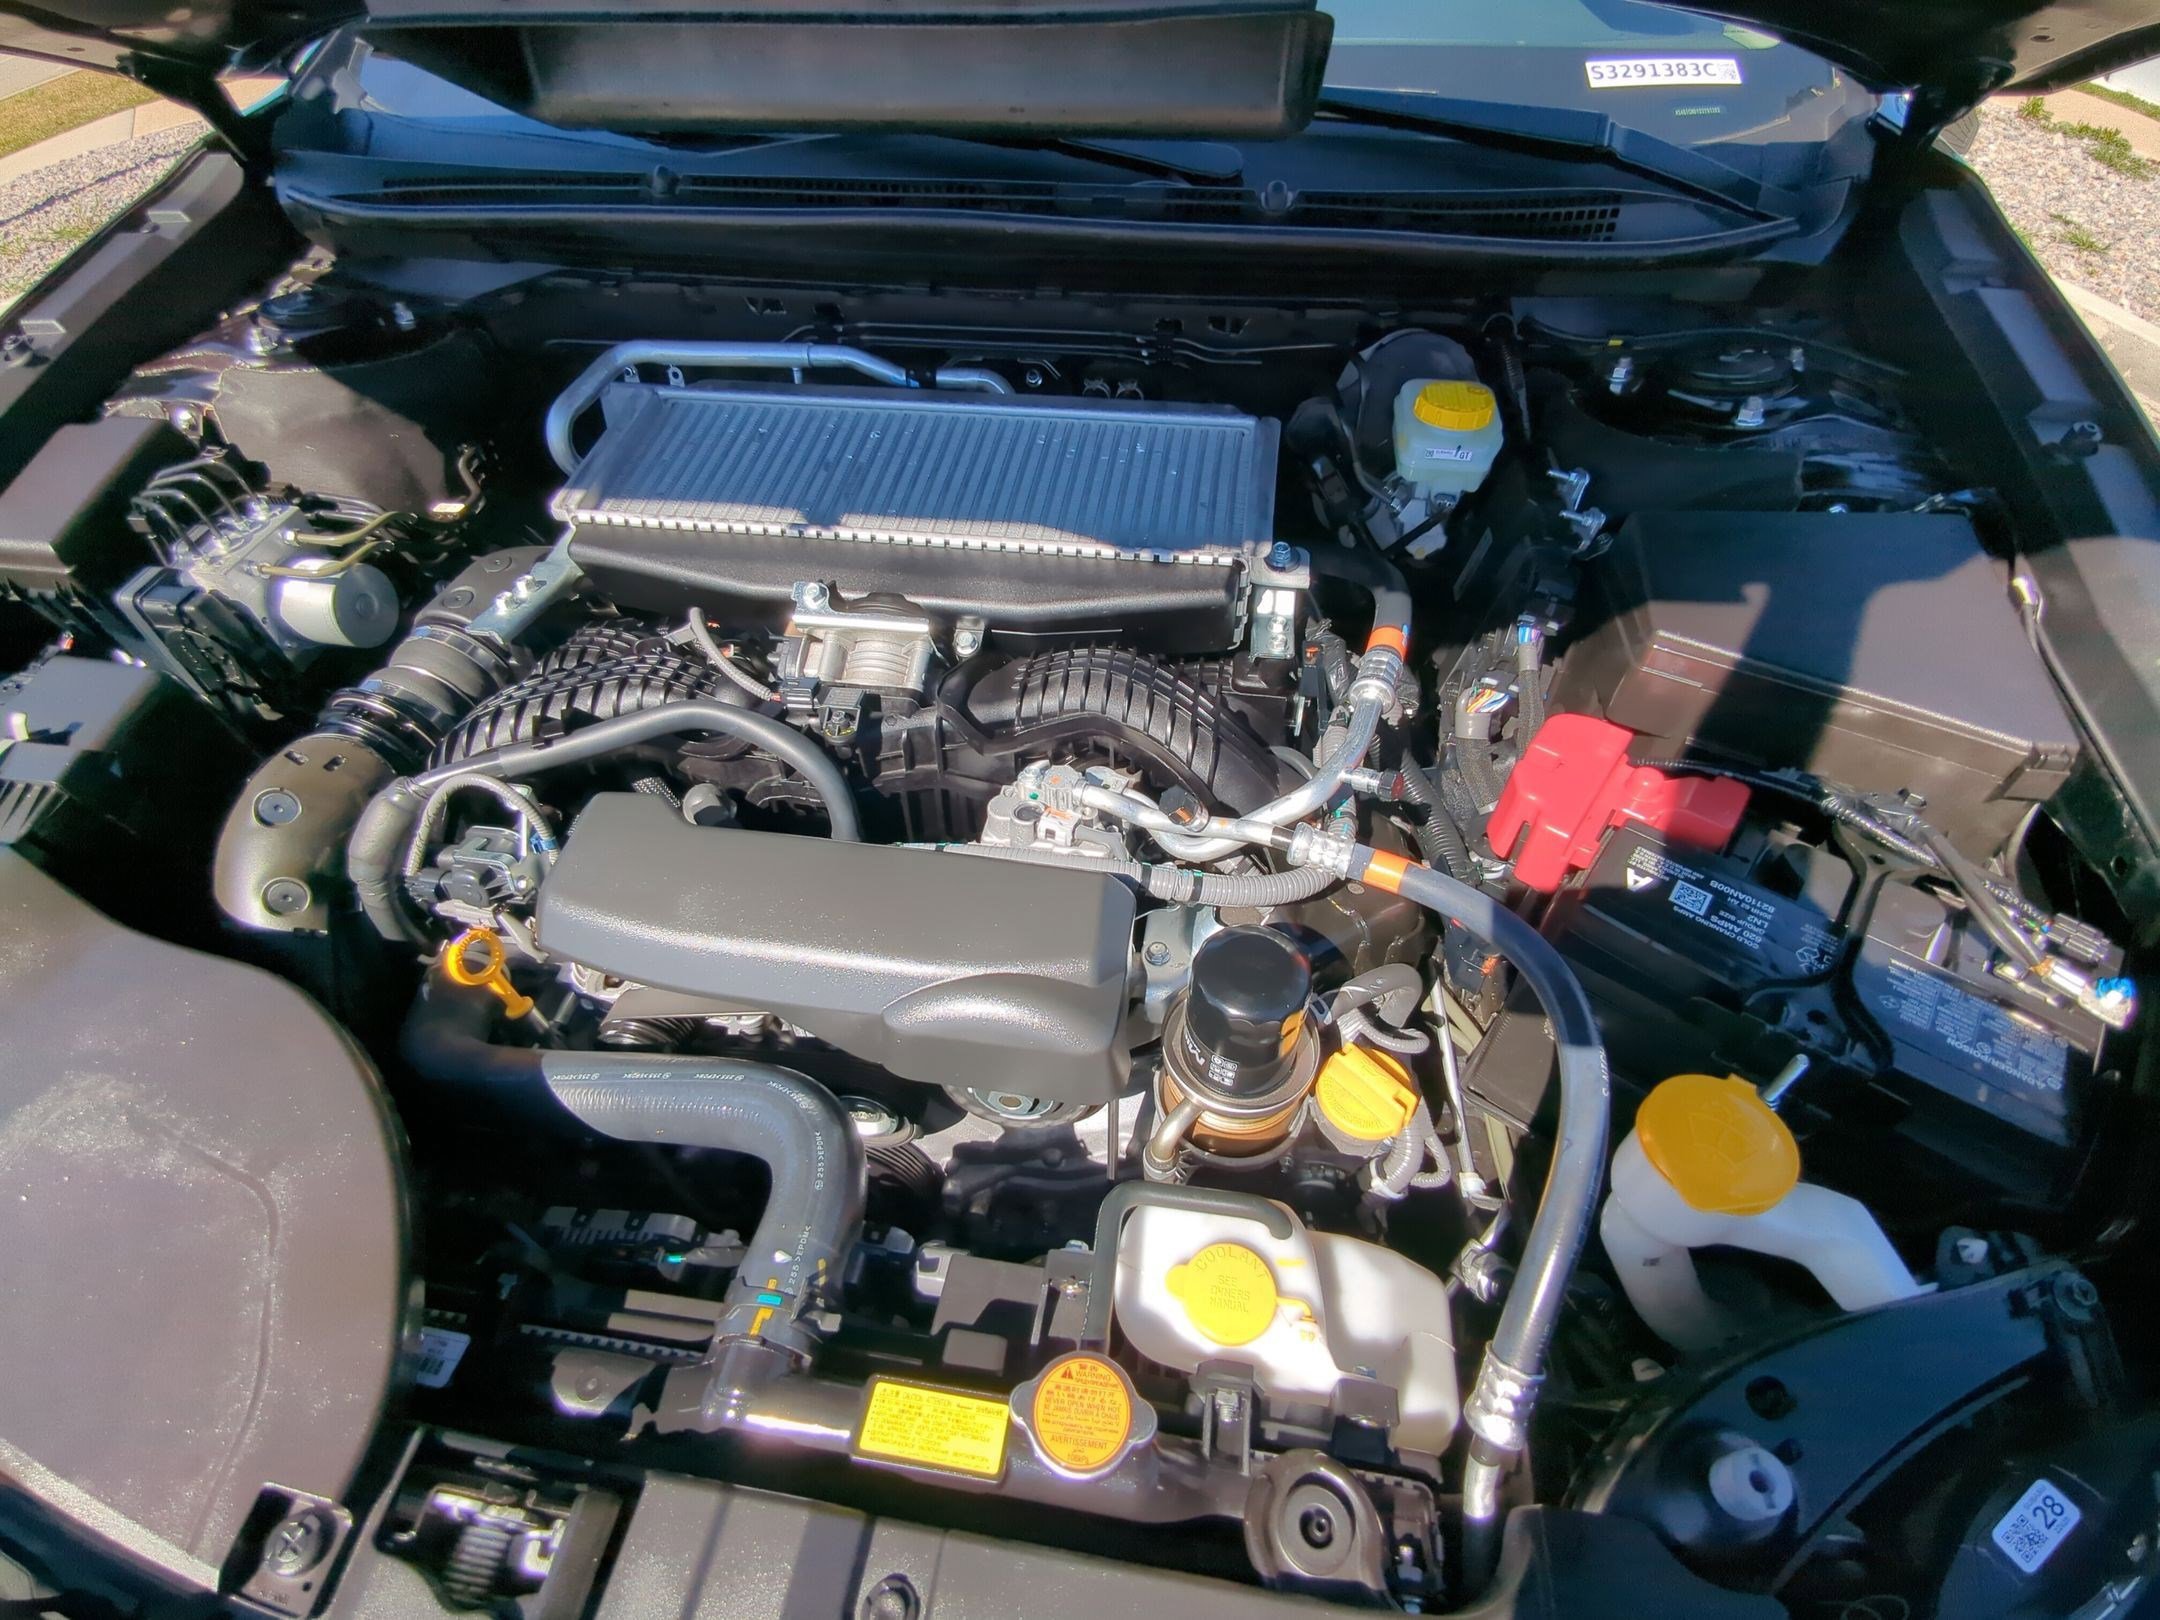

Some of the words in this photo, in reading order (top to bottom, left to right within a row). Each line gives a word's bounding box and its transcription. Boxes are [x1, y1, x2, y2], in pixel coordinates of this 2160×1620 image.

[1591, 62, 1717, 80] S3291383C
[1672, 905, 1695, 918] AMPS
[1718, 909, 1736, 921] SIZE
[1694, 915, 1736, 938] CRANKING
[1709, 914, 1742, 933] AMPS
[1736, 918, 1765, 935] GROUP
[1746, 914, 1768, 928] LN2
[1736, 934, 1759, 949] COLD
[1742, 929, 1762, 943] 620
[1196, 1246, 1269, 1278] COOLANT
[1218, 1275, 1237, 1287] SEE
[1210, 1296, 1248, 1312] MANUAL
[1075, 1370, 1111, 1380] WARNING
[1050, 1434, 1107, 1449] AVERTISSEMENT
[2033, 1495, 2064, 1530] 28
